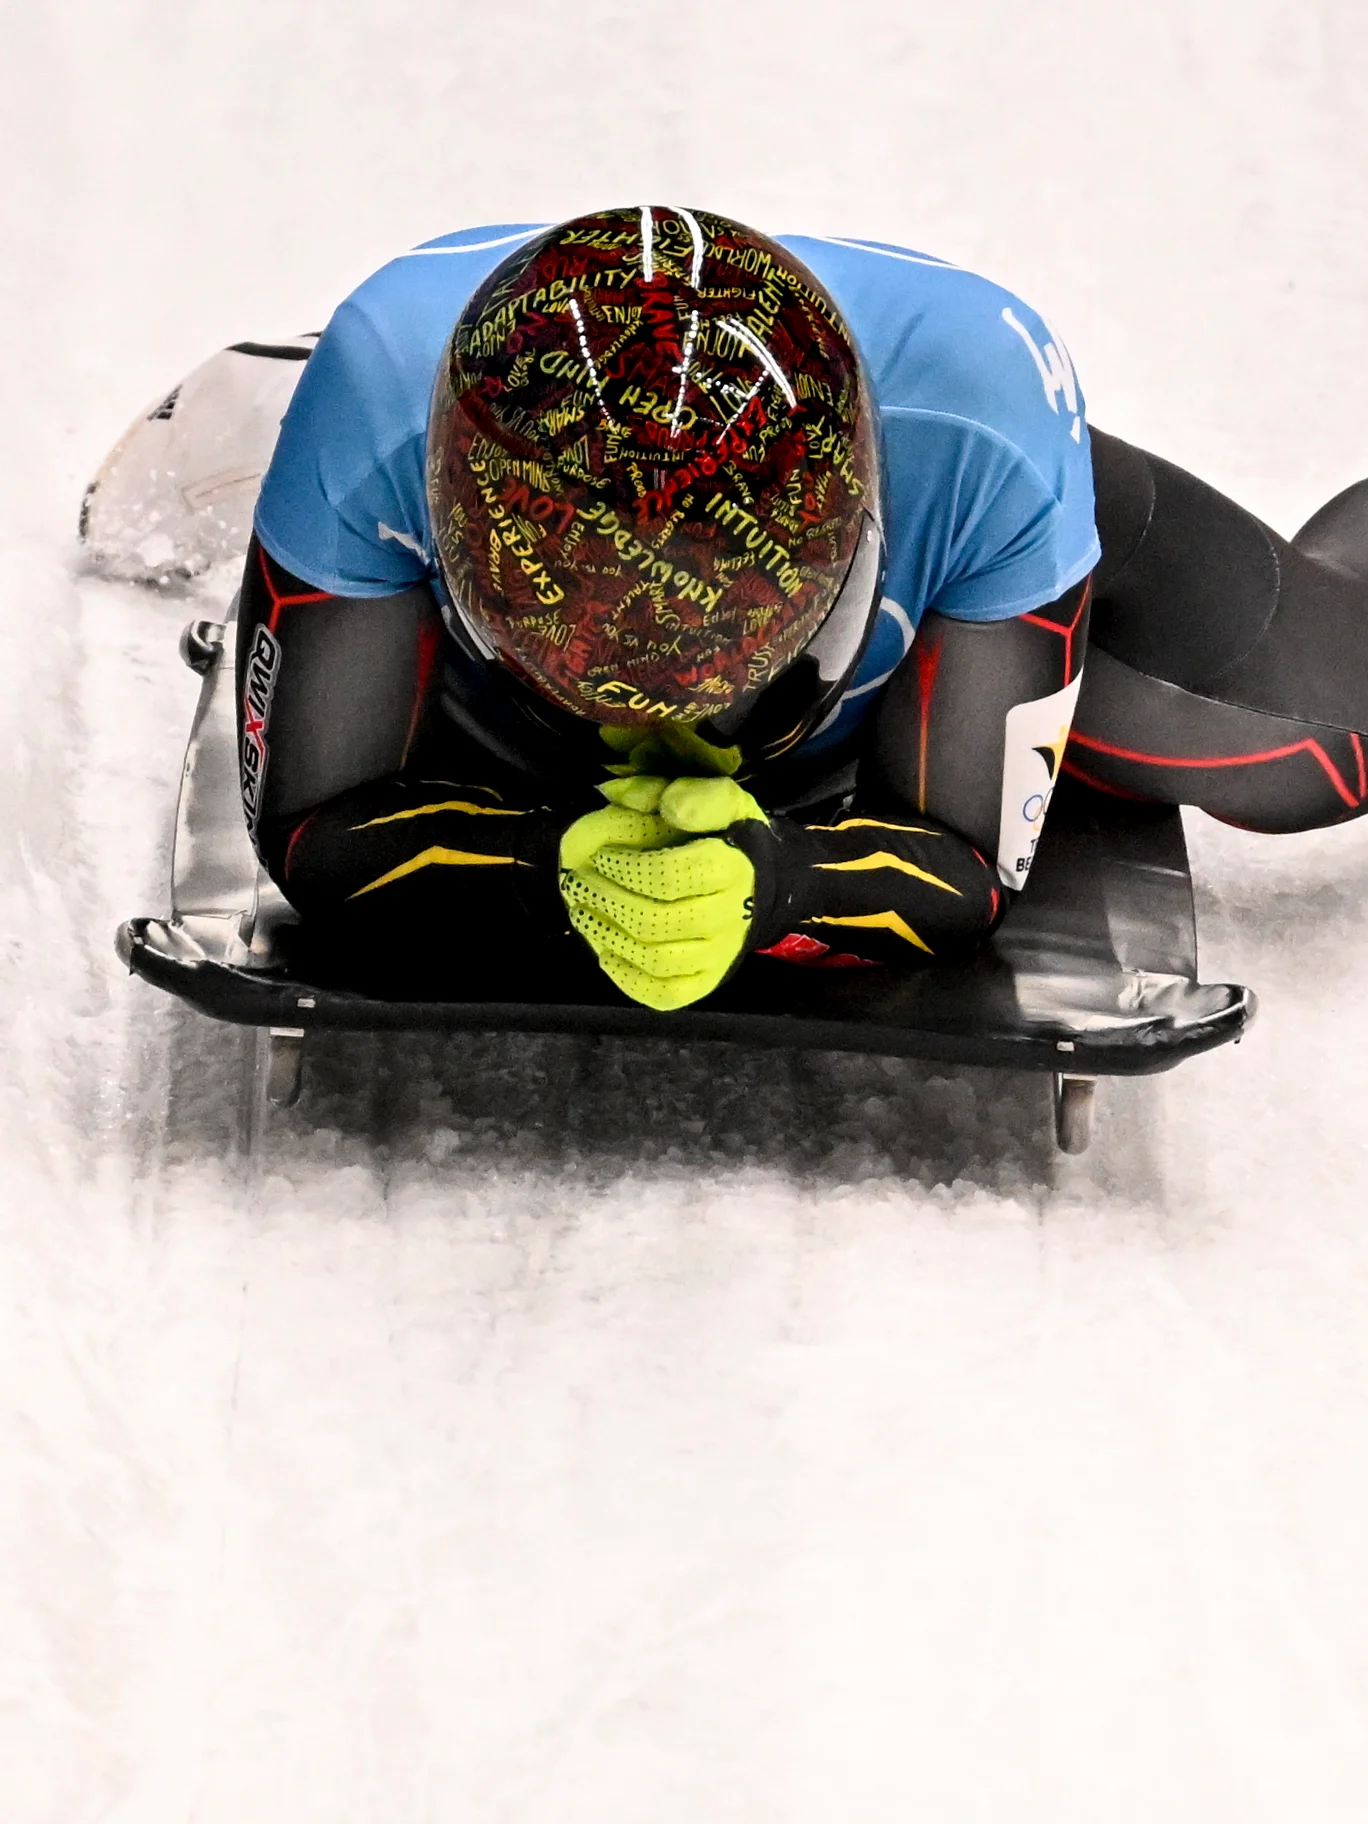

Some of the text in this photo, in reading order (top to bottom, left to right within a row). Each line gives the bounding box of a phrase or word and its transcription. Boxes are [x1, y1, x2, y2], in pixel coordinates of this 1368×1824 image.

[470, 268, 638, 357] ADAPTABILITY
[618, 385, 697, 431] OPEN
[489, 459, 521, 481] OPEN
[619, 448, 685, 463] INTUITION
[786, 468, 803, 505] FUN
[470, 459, 566, 606] EXPERIENCE
[704, 492, 804, 599] INTUITION
[576, 502, 723, 613] KNOWLEDGE
[596, 680, 678, 718] FUN
